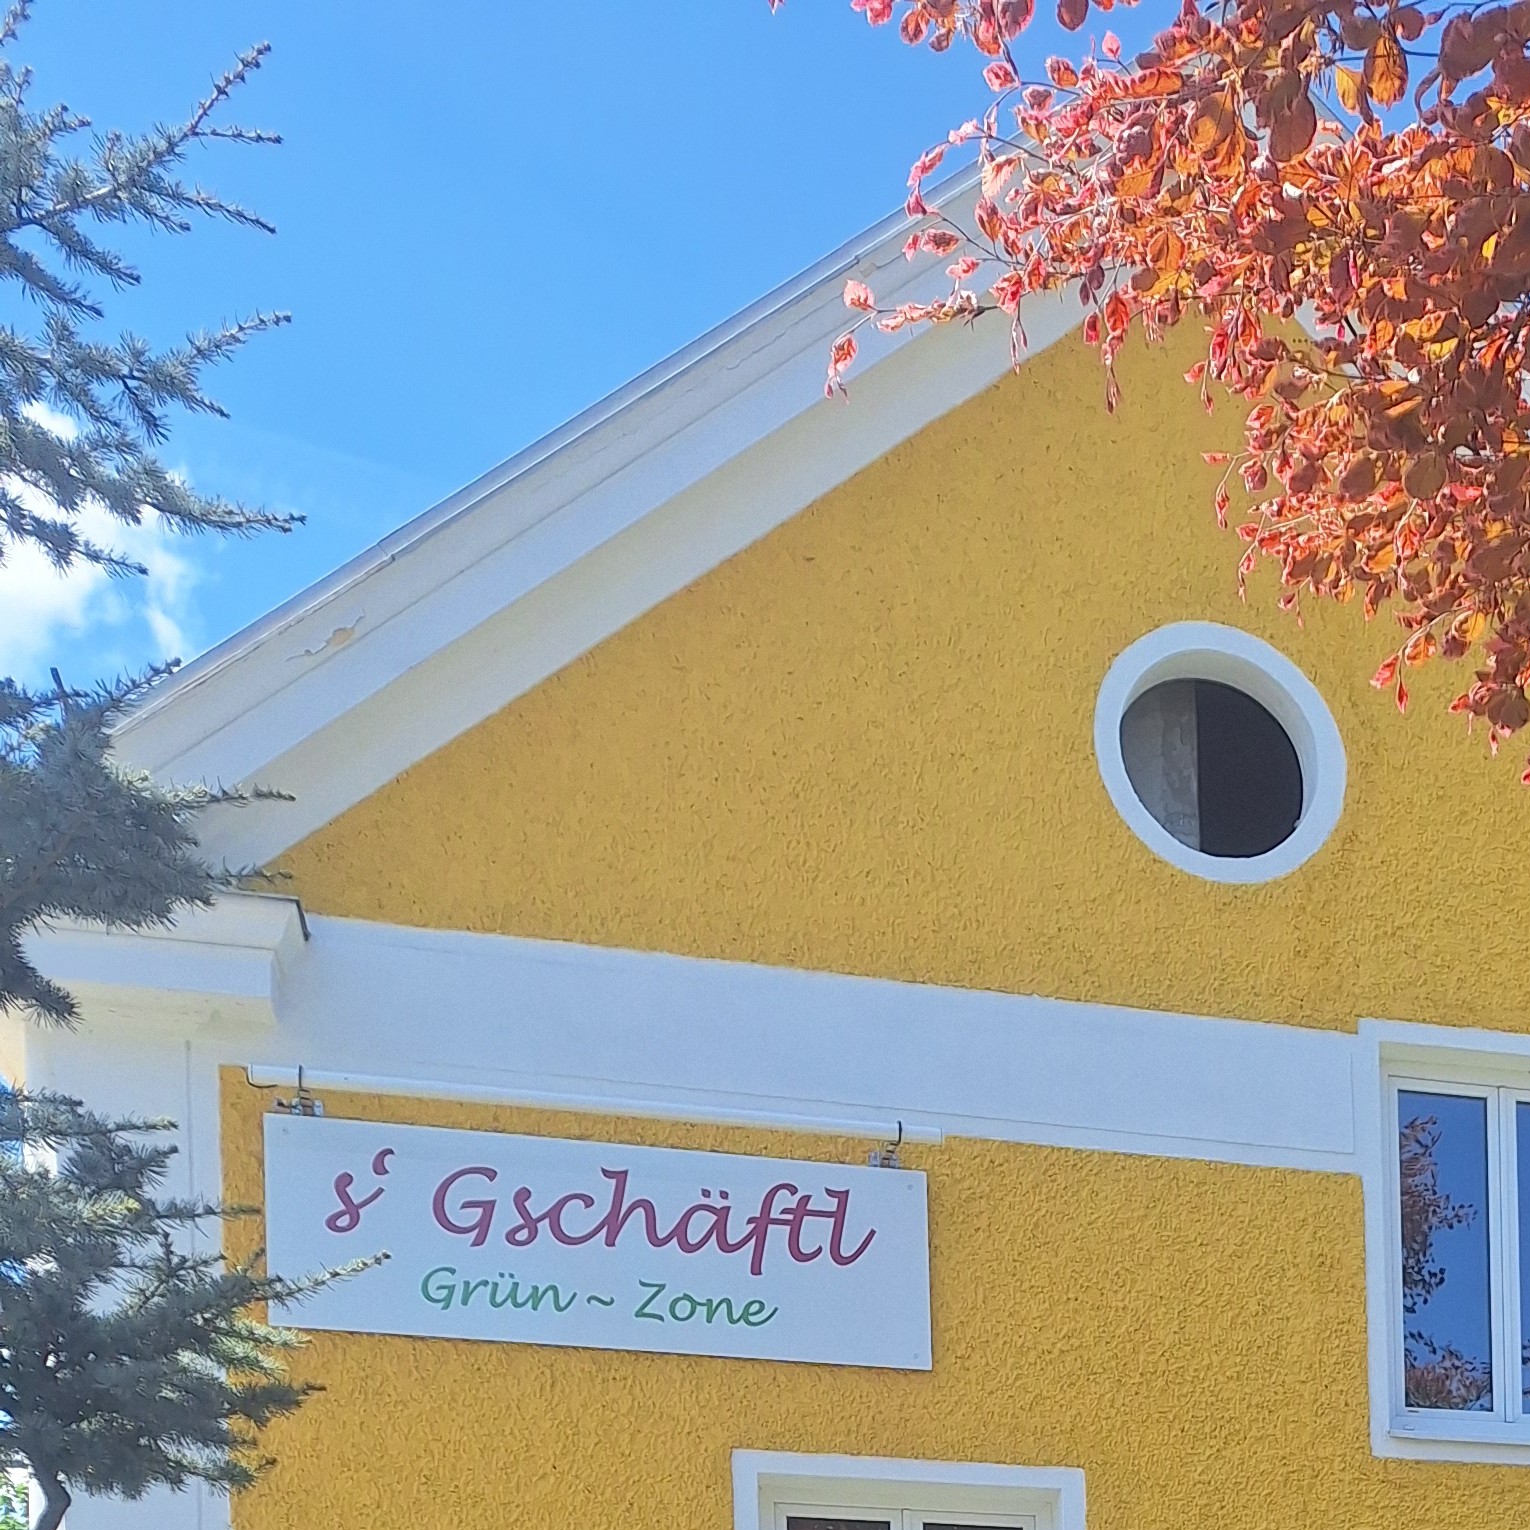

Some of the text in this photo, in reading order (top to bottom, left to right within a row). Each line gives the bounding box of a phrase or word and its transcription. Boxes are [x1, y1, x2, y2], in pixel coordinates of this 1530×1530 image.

[432, 1166, 877, 1277] Gschäftl
[420, 1266, 578, 1313] Grün
[634, 1279, 779, 1327] Zone
